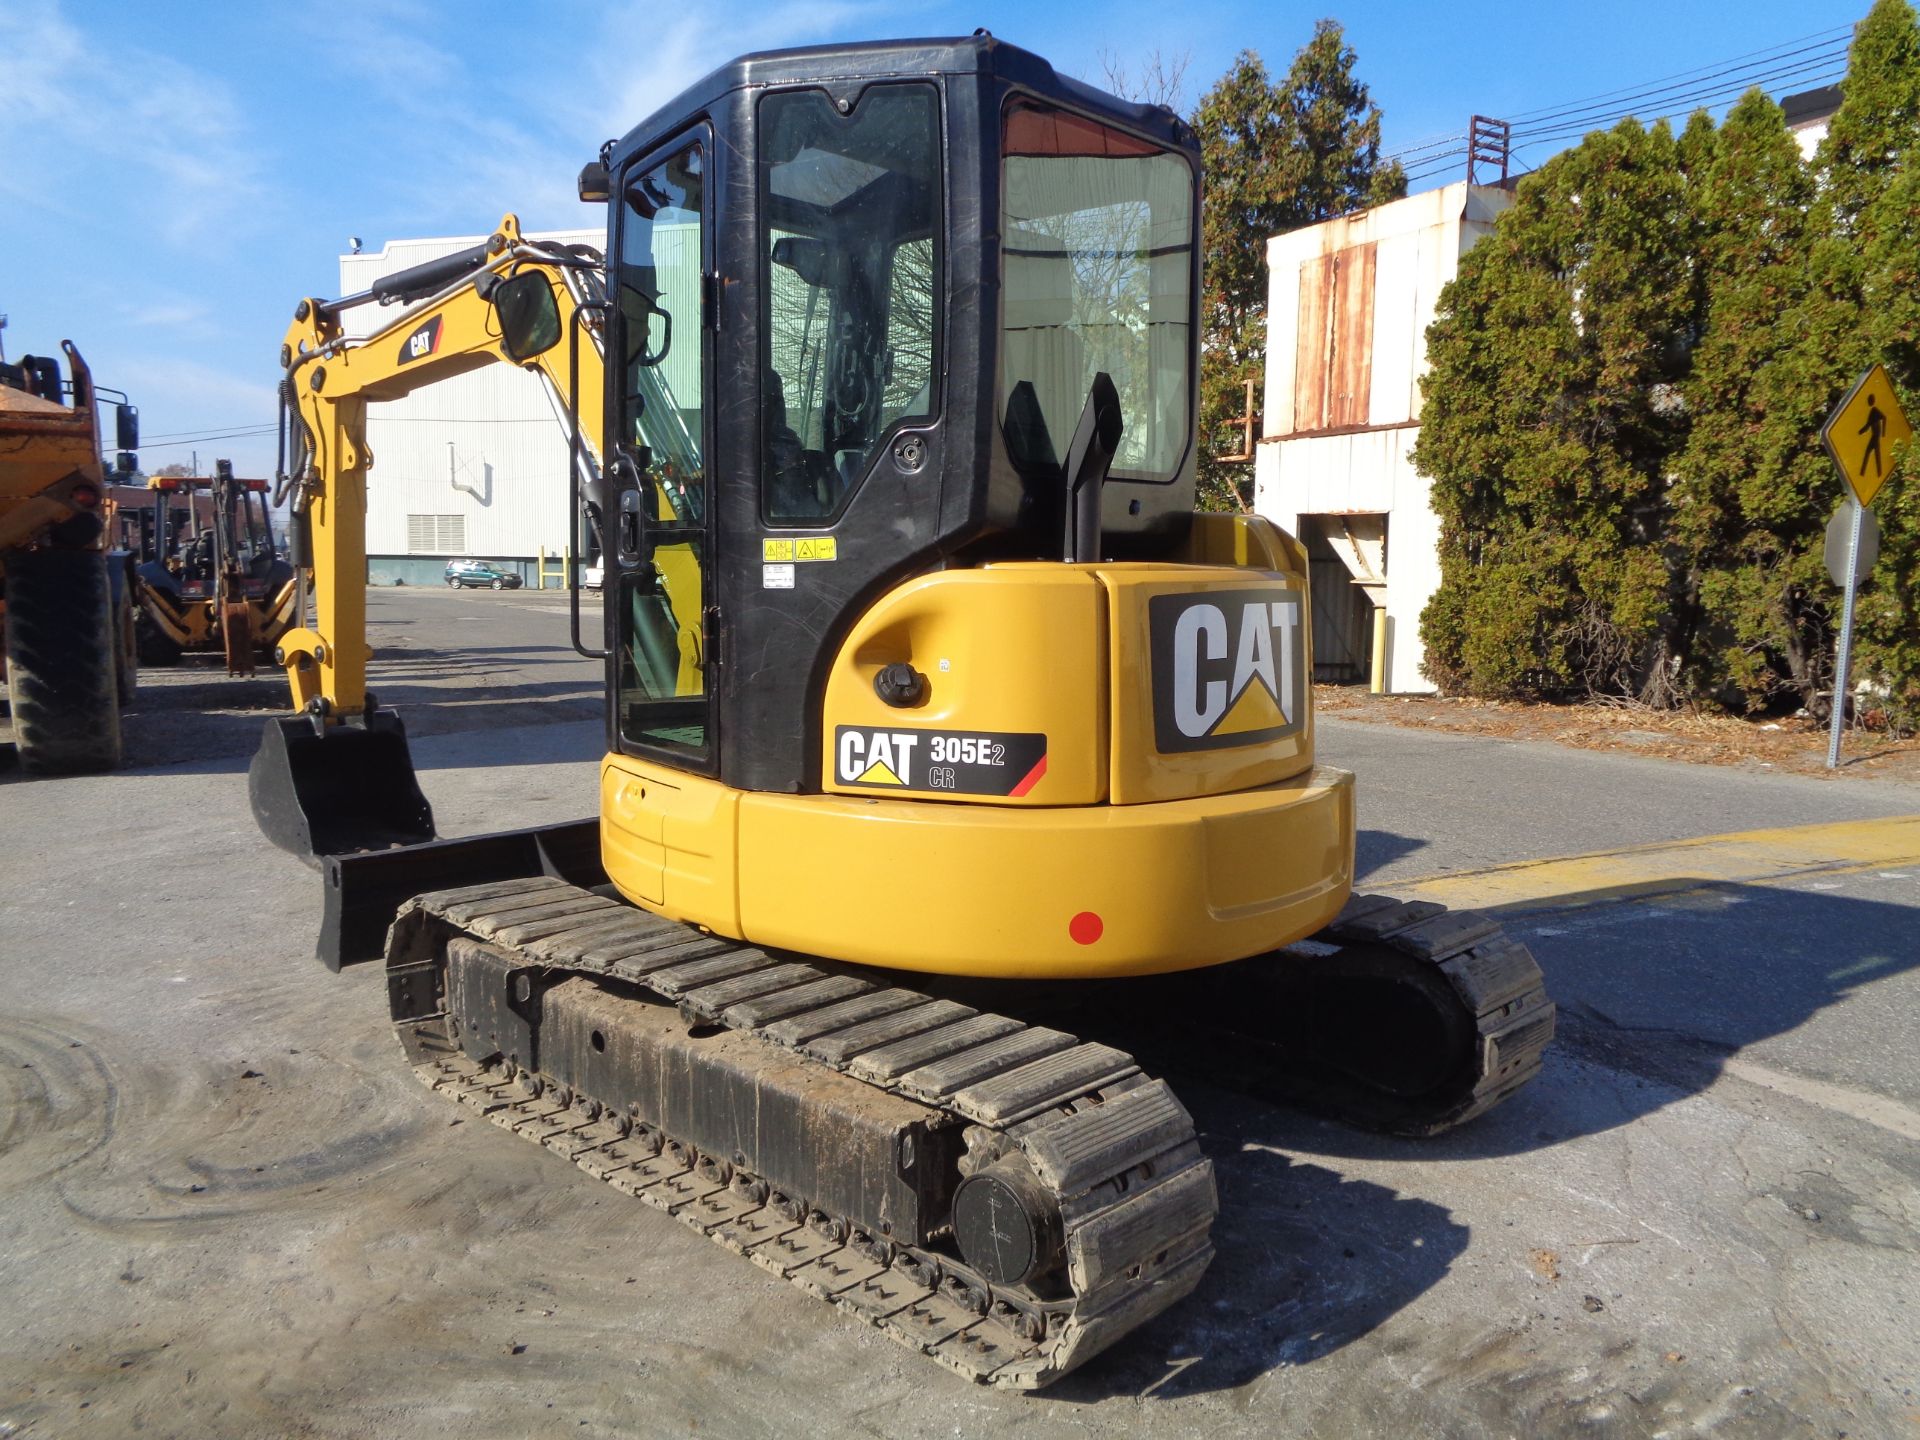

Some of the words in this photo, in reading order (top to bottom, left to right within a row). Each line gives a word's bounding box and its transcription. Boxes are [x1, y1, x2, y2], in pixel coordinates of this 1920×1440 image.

[411, 331, 430, 357] CAT
[1174, 602, 1298, 738] CAT
[839, 730, 918, 786] CAT
[930, 736, 1005, 766] 305E2
[929, 766, 955, 789] CR
